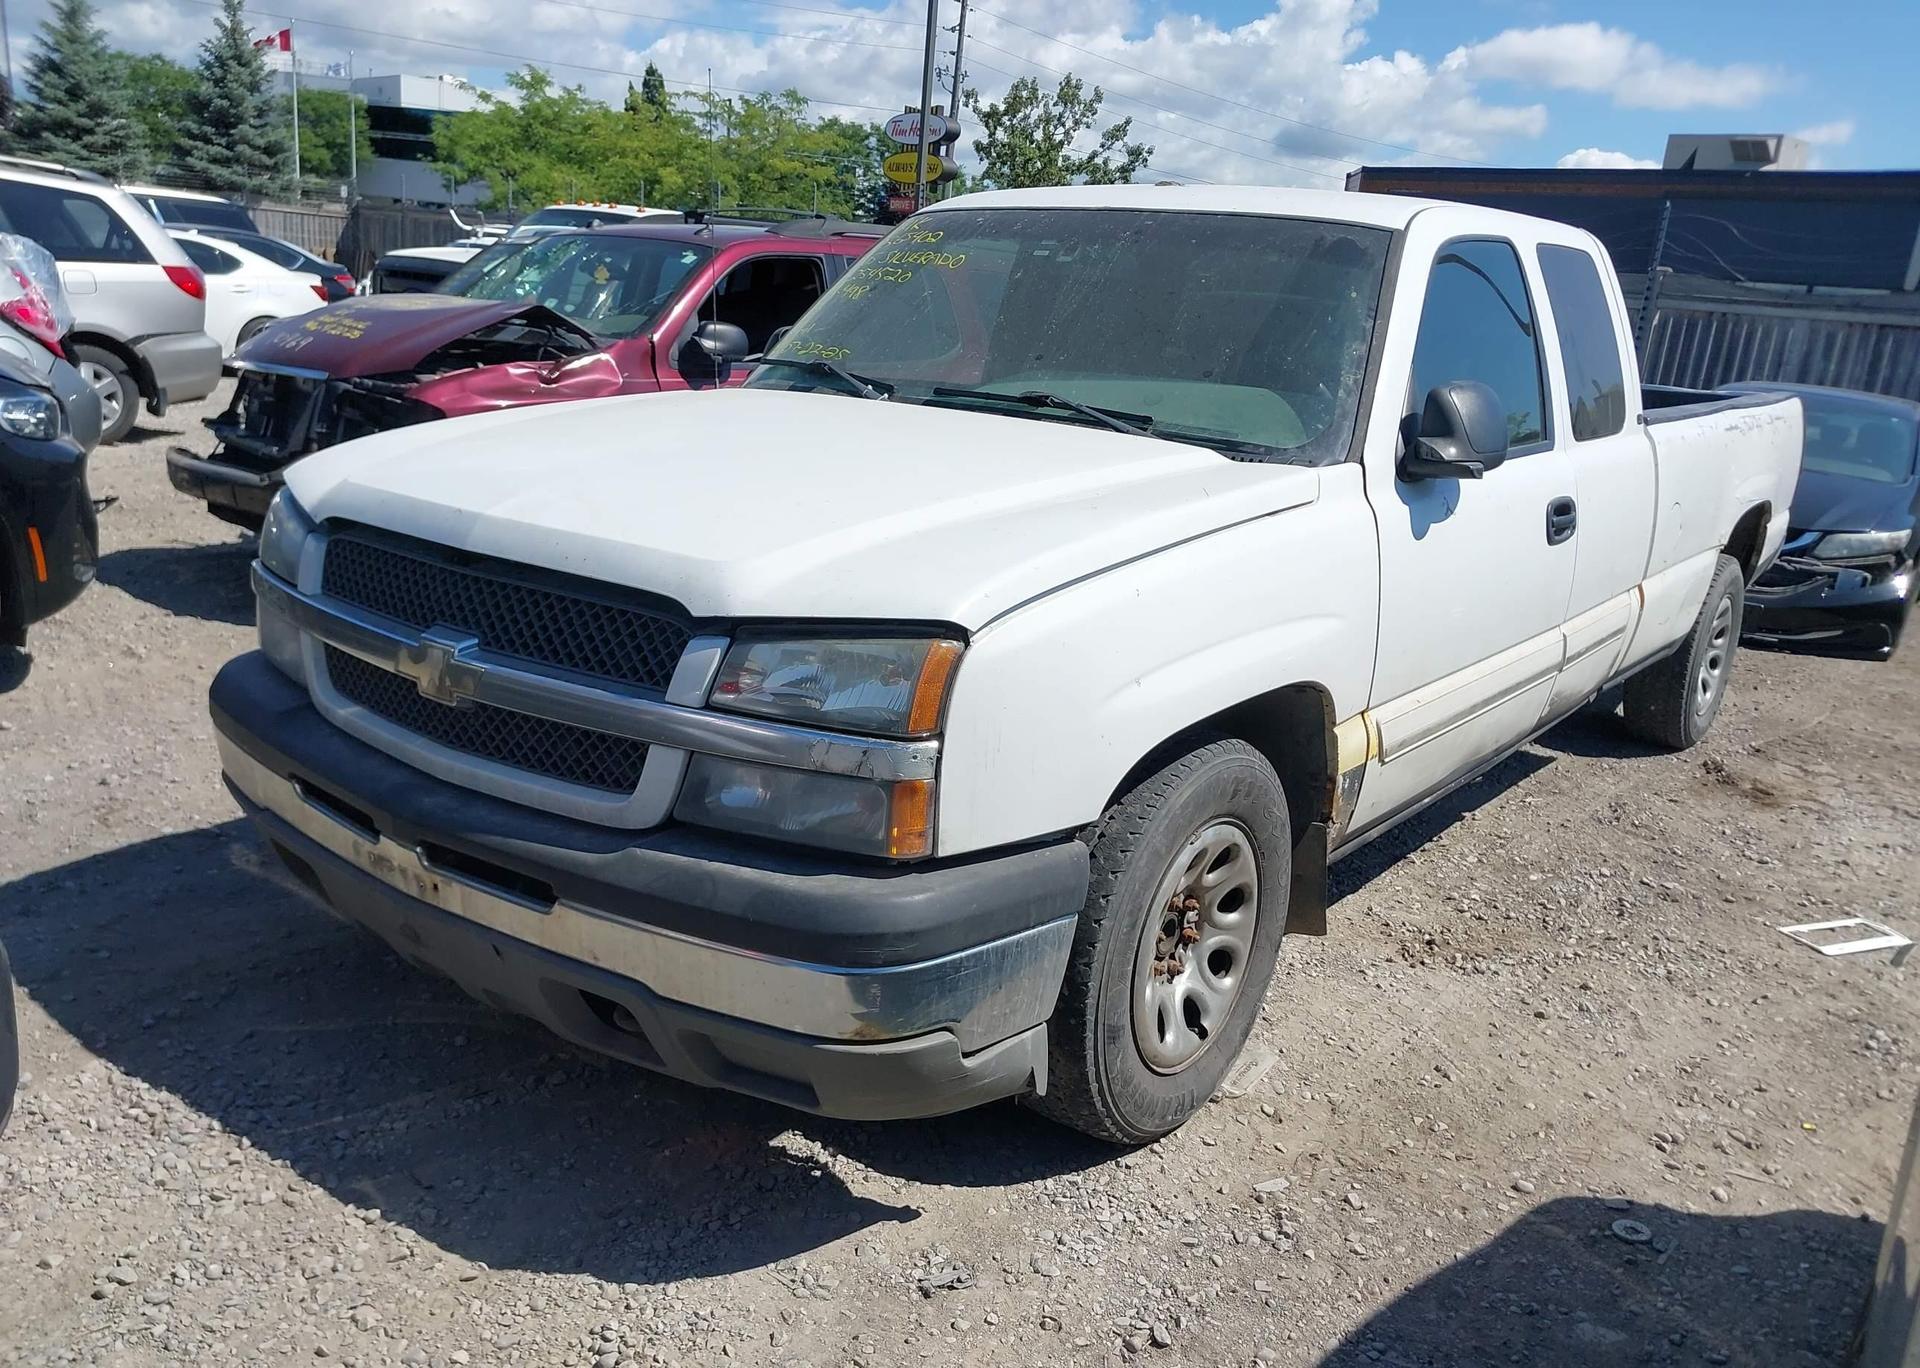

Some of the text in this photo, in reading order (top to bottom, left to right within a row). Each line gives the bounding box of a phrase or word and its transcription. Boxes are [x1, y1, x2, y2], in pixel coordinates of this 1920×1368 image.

[891, 119, 942, 137] Tim Hoons
[887, 162, 914, 173] ALWAYS
